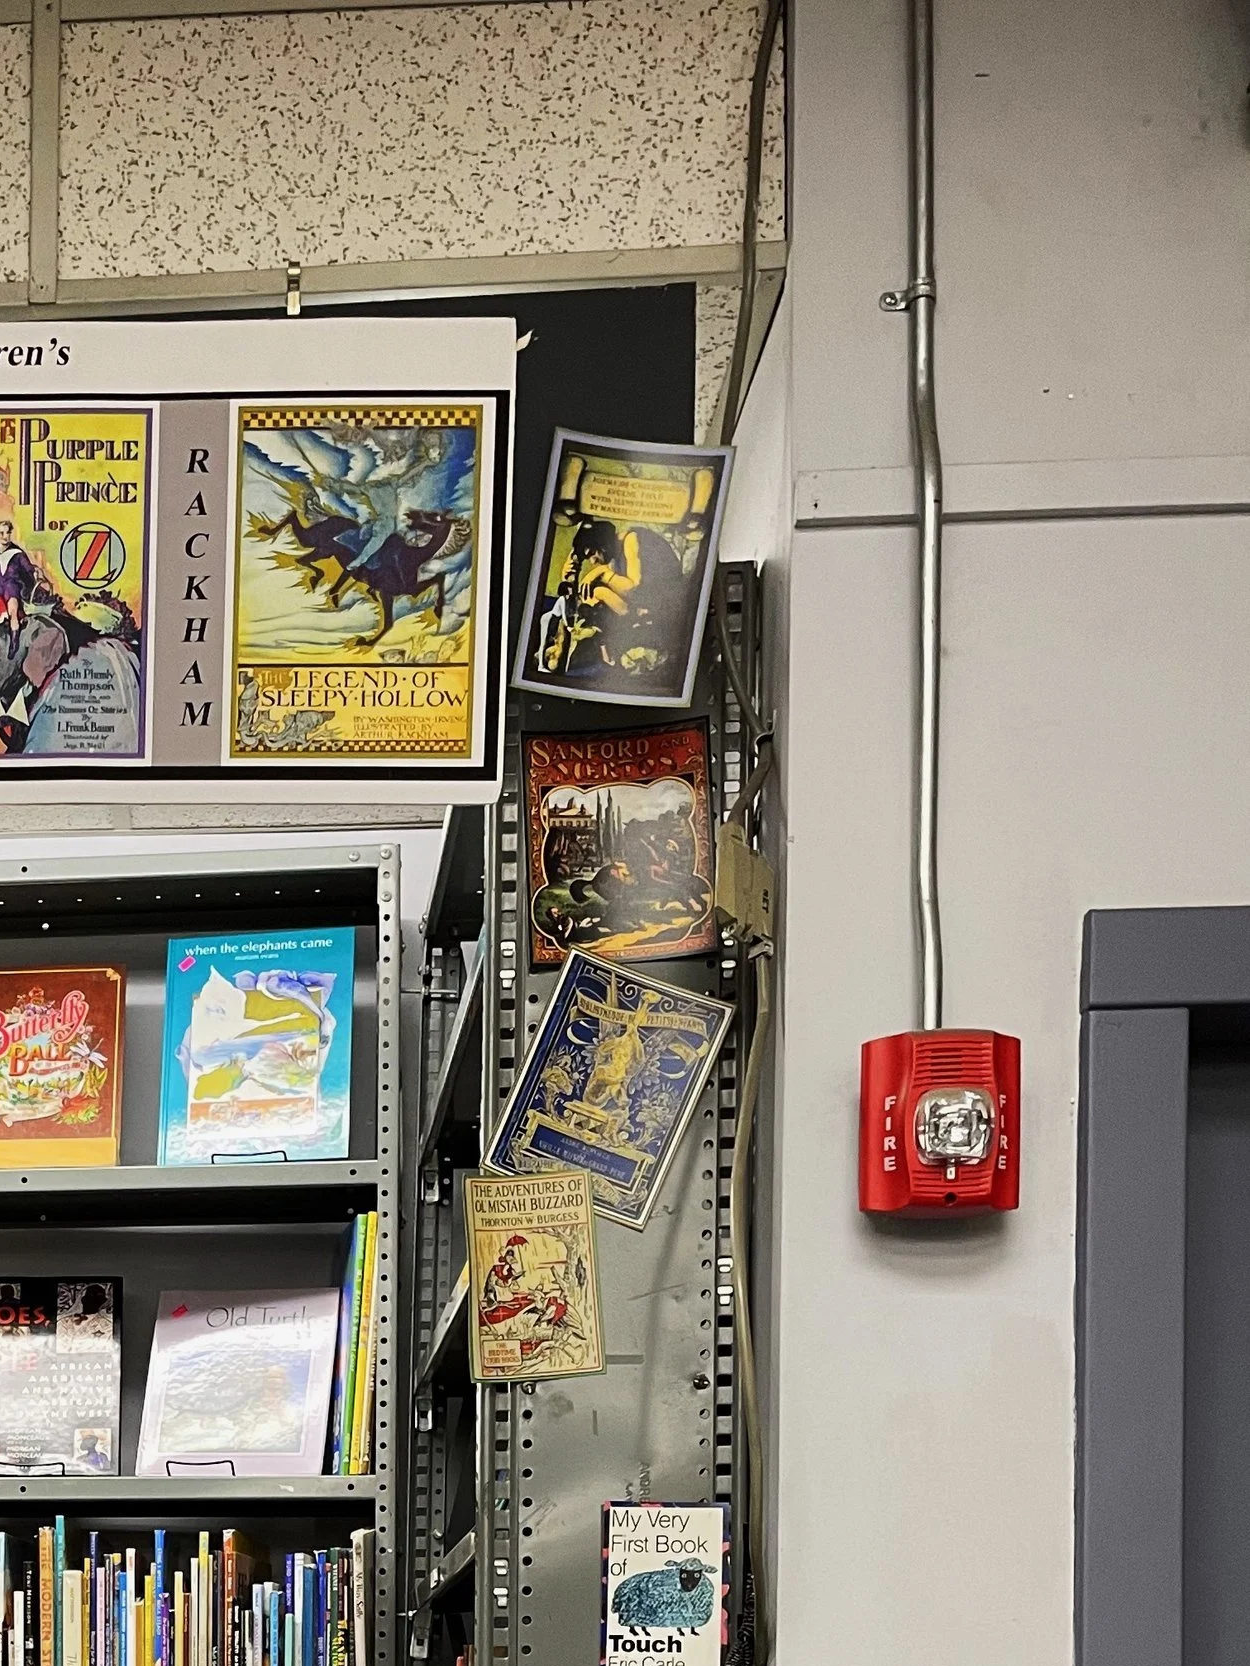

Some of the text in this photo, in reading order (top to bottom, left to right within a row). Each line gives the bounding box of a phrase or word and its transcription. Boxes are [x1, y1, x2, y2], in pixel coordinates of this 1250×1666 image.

[19, 418, 139, 505] PURPLE
[33, 460, 138, 531] PRINCE
[48, 520, 68, 531] OF
[181, 448, 211, 728] RACKHAM
[61, 680, 115, 693] Thompson
[292, 670, 445, 688] LEGEND OF
[261, 690, 468, 707] SLEEPY HOLLOW
[531, 739, 650, 768] SANFORD
[185, 938, 333, 957] when the elephants came
[9, 1042, 72, 1077] BALL
[883, 1096, 897, 1172] FIRE
[998, 1094, 1008, 1170] FIRE
[473, 1179, 583, 1198] THE ADVENTURES OF
[488, 1193, 583, 1213] MISTAH BUZZARD
[481, 1212, 580, 1227] THORNTON BURGESS
[207, 1306, 248, 1328] Old
[28, 1375, 112, 1383] AMERICANS
[612, 1510, 690, 1532] My Very
[611, 1534, 709, 1553] First Book
[610, 1558, 627, 1576] of
[41, 1578, 53, 1641] MODERN
[608, 1635, 682, 1653] Touch
